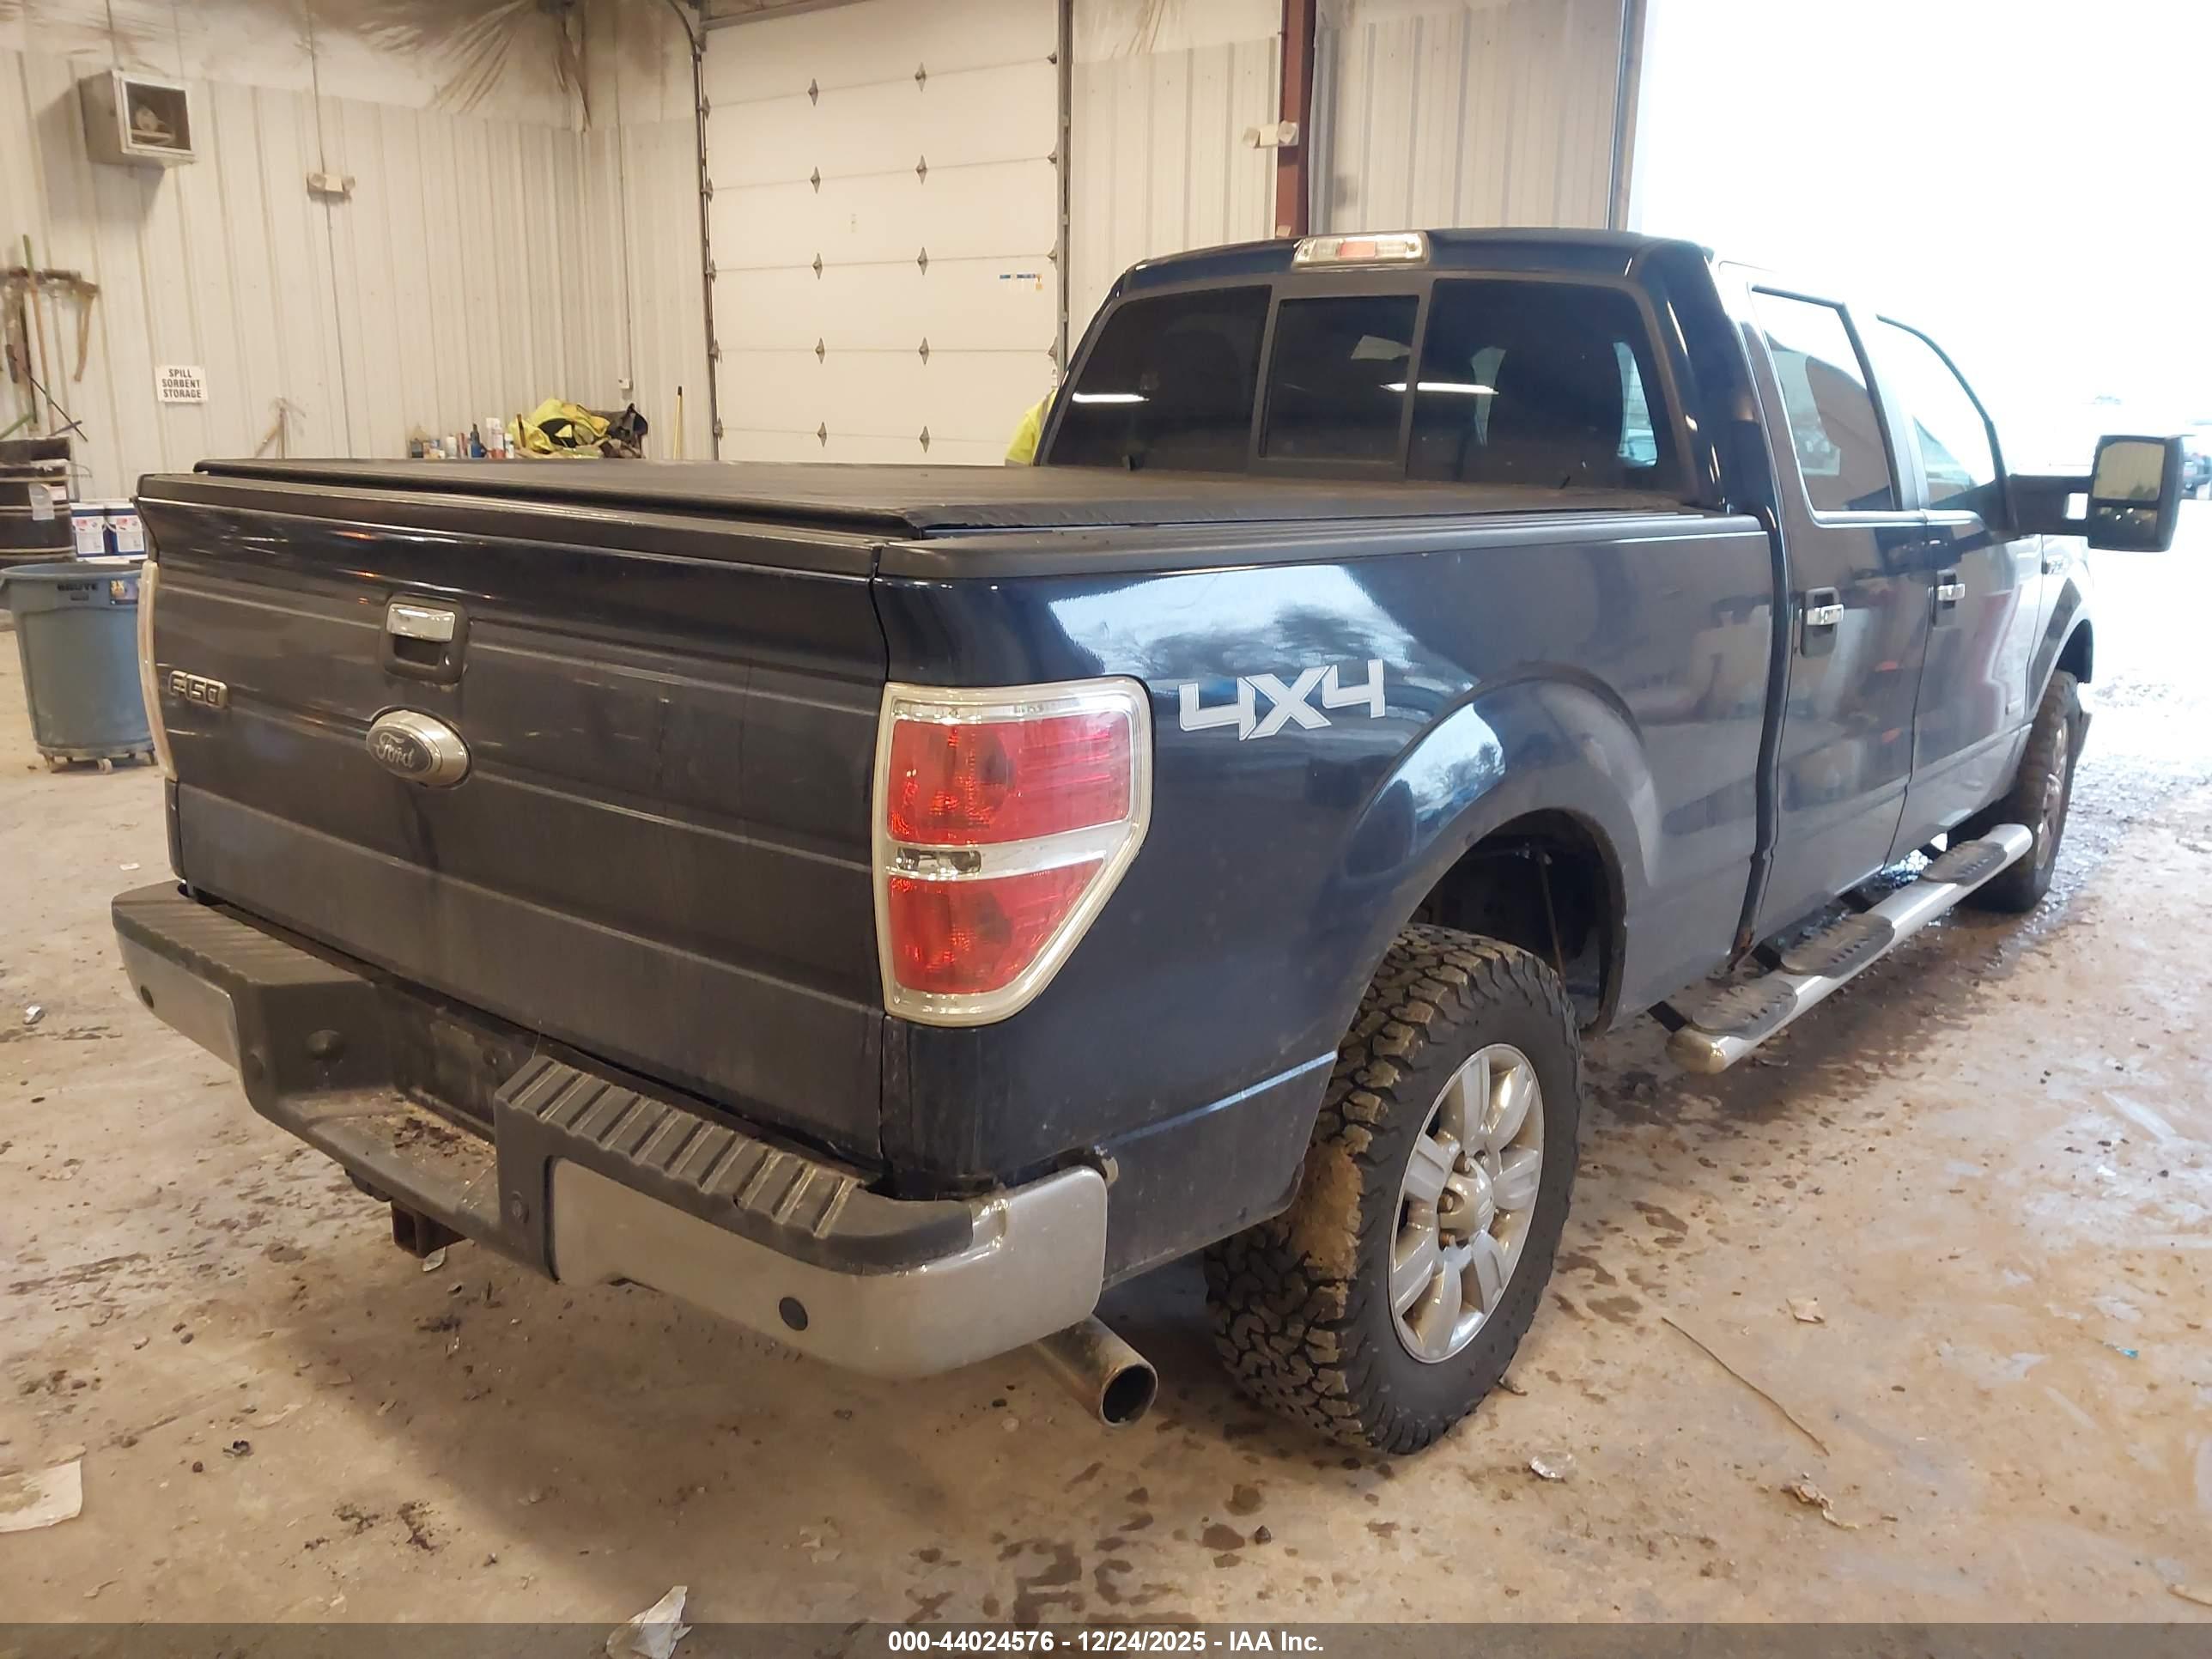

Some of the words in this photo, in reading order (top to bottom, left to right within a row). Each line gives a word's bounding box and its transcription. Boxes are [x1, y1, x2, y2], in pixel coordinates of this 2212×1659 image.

[168, 368, 191, 378] SPILL
[161, 378, 200, 388] SORBENT
[163, 389, 202, 398] STORAGE
[373, 732, 415, 769] Ford
